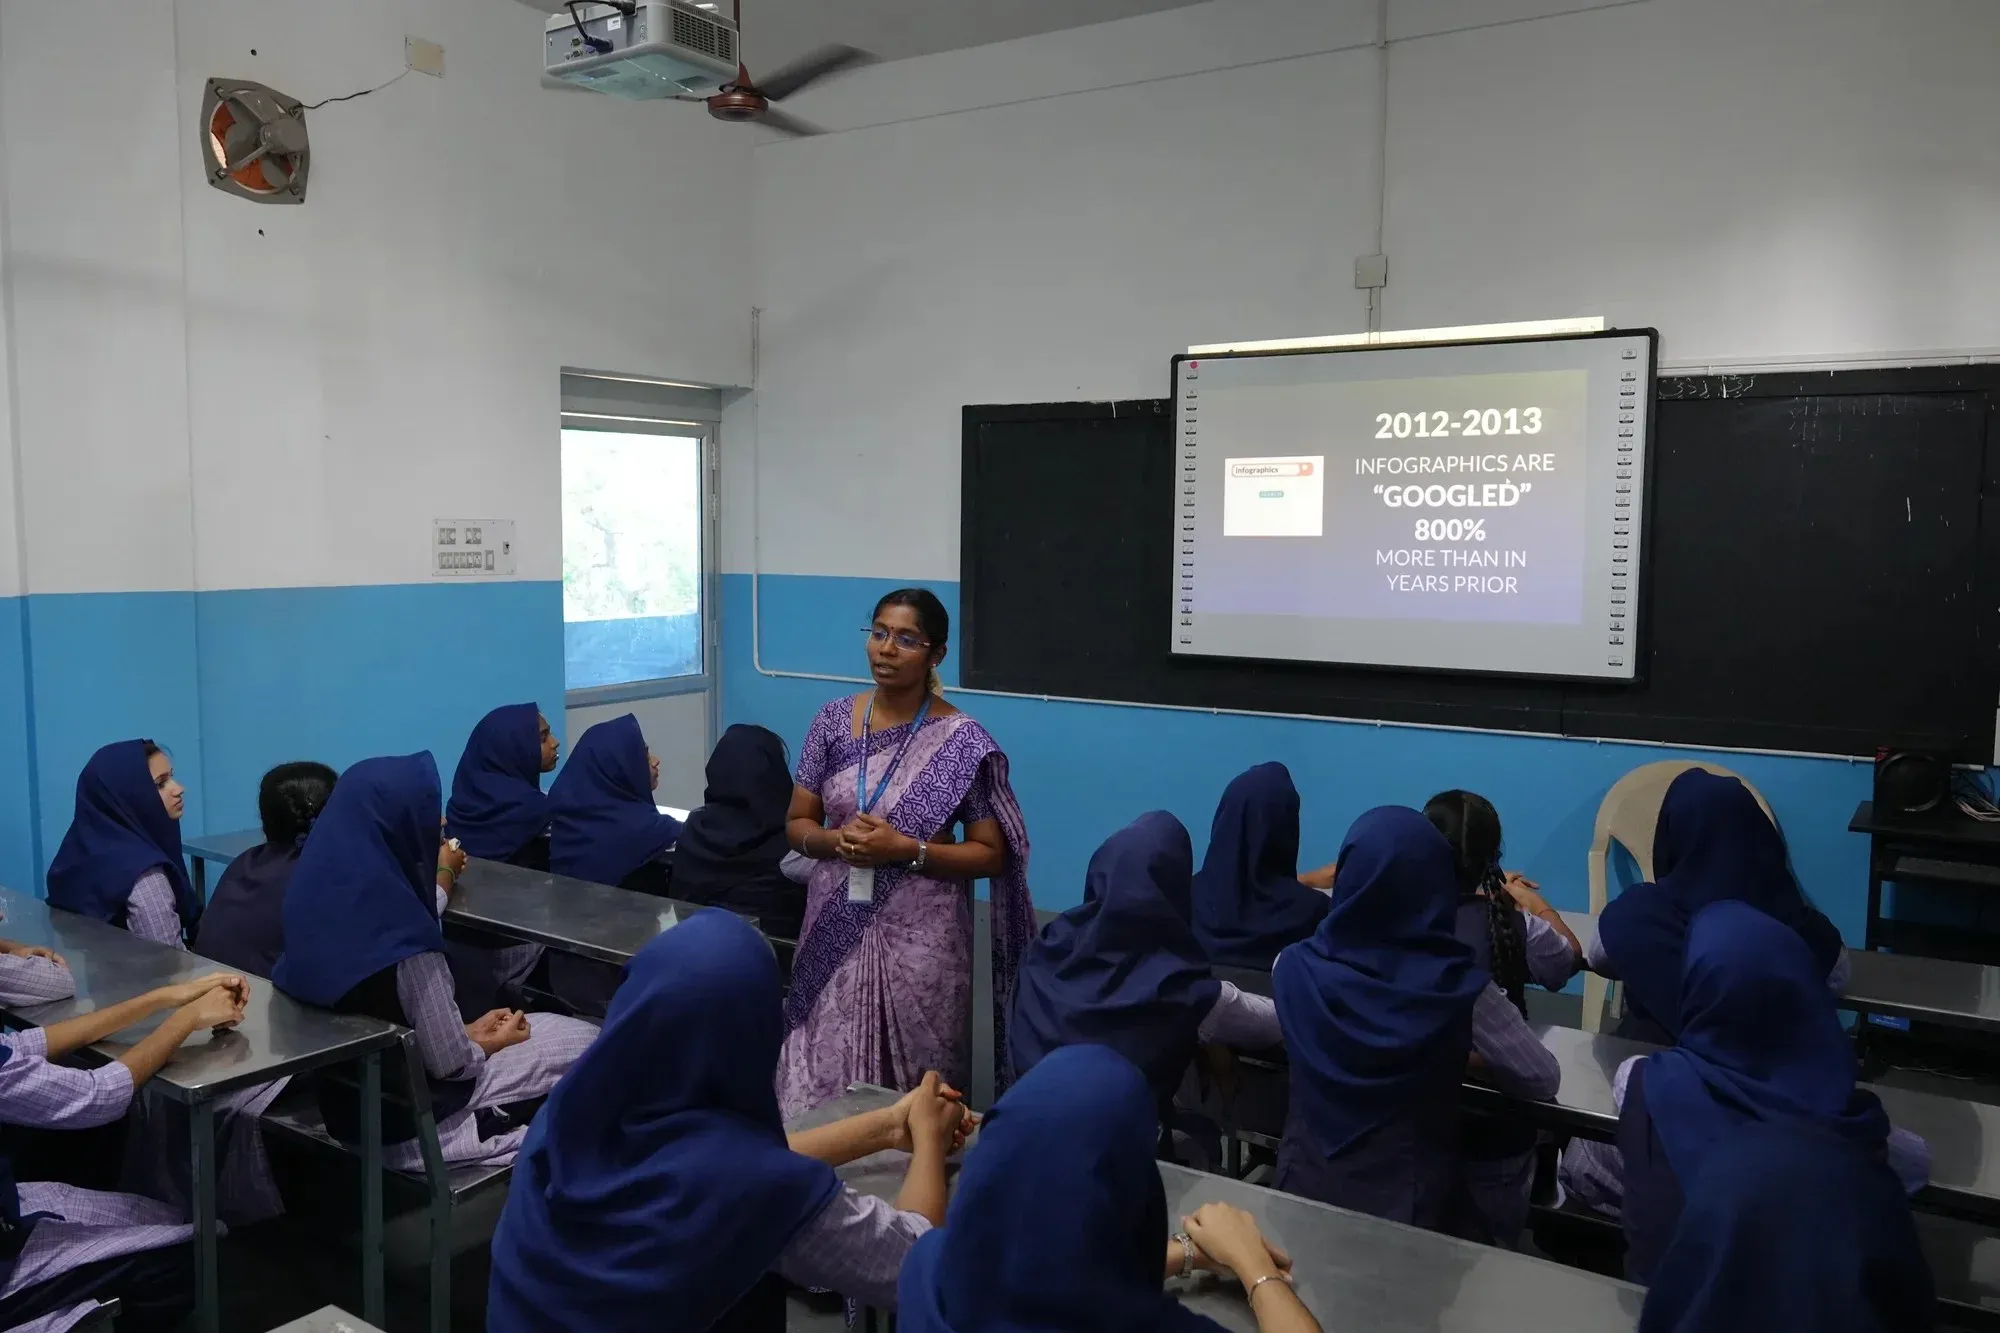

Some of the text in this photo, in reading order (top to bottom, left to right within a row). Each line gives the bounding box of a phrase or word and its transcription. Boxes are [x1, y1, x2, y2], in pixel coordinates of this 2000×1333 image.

[1375, 407, 1542, 438] 2012-2013
[1235, 466, 1279, 475] infographics
[1355, 454, 1556, 475] INFOGRAPHICS ARE
[1374, 483, 1532, 507] “GOOGLED”
[1415, 518, 1487, 541] 800%
[1376, 549, 1526, 568] MORE THAN IN
[1386, 574, 1518, 594] YEARS PRIOR
